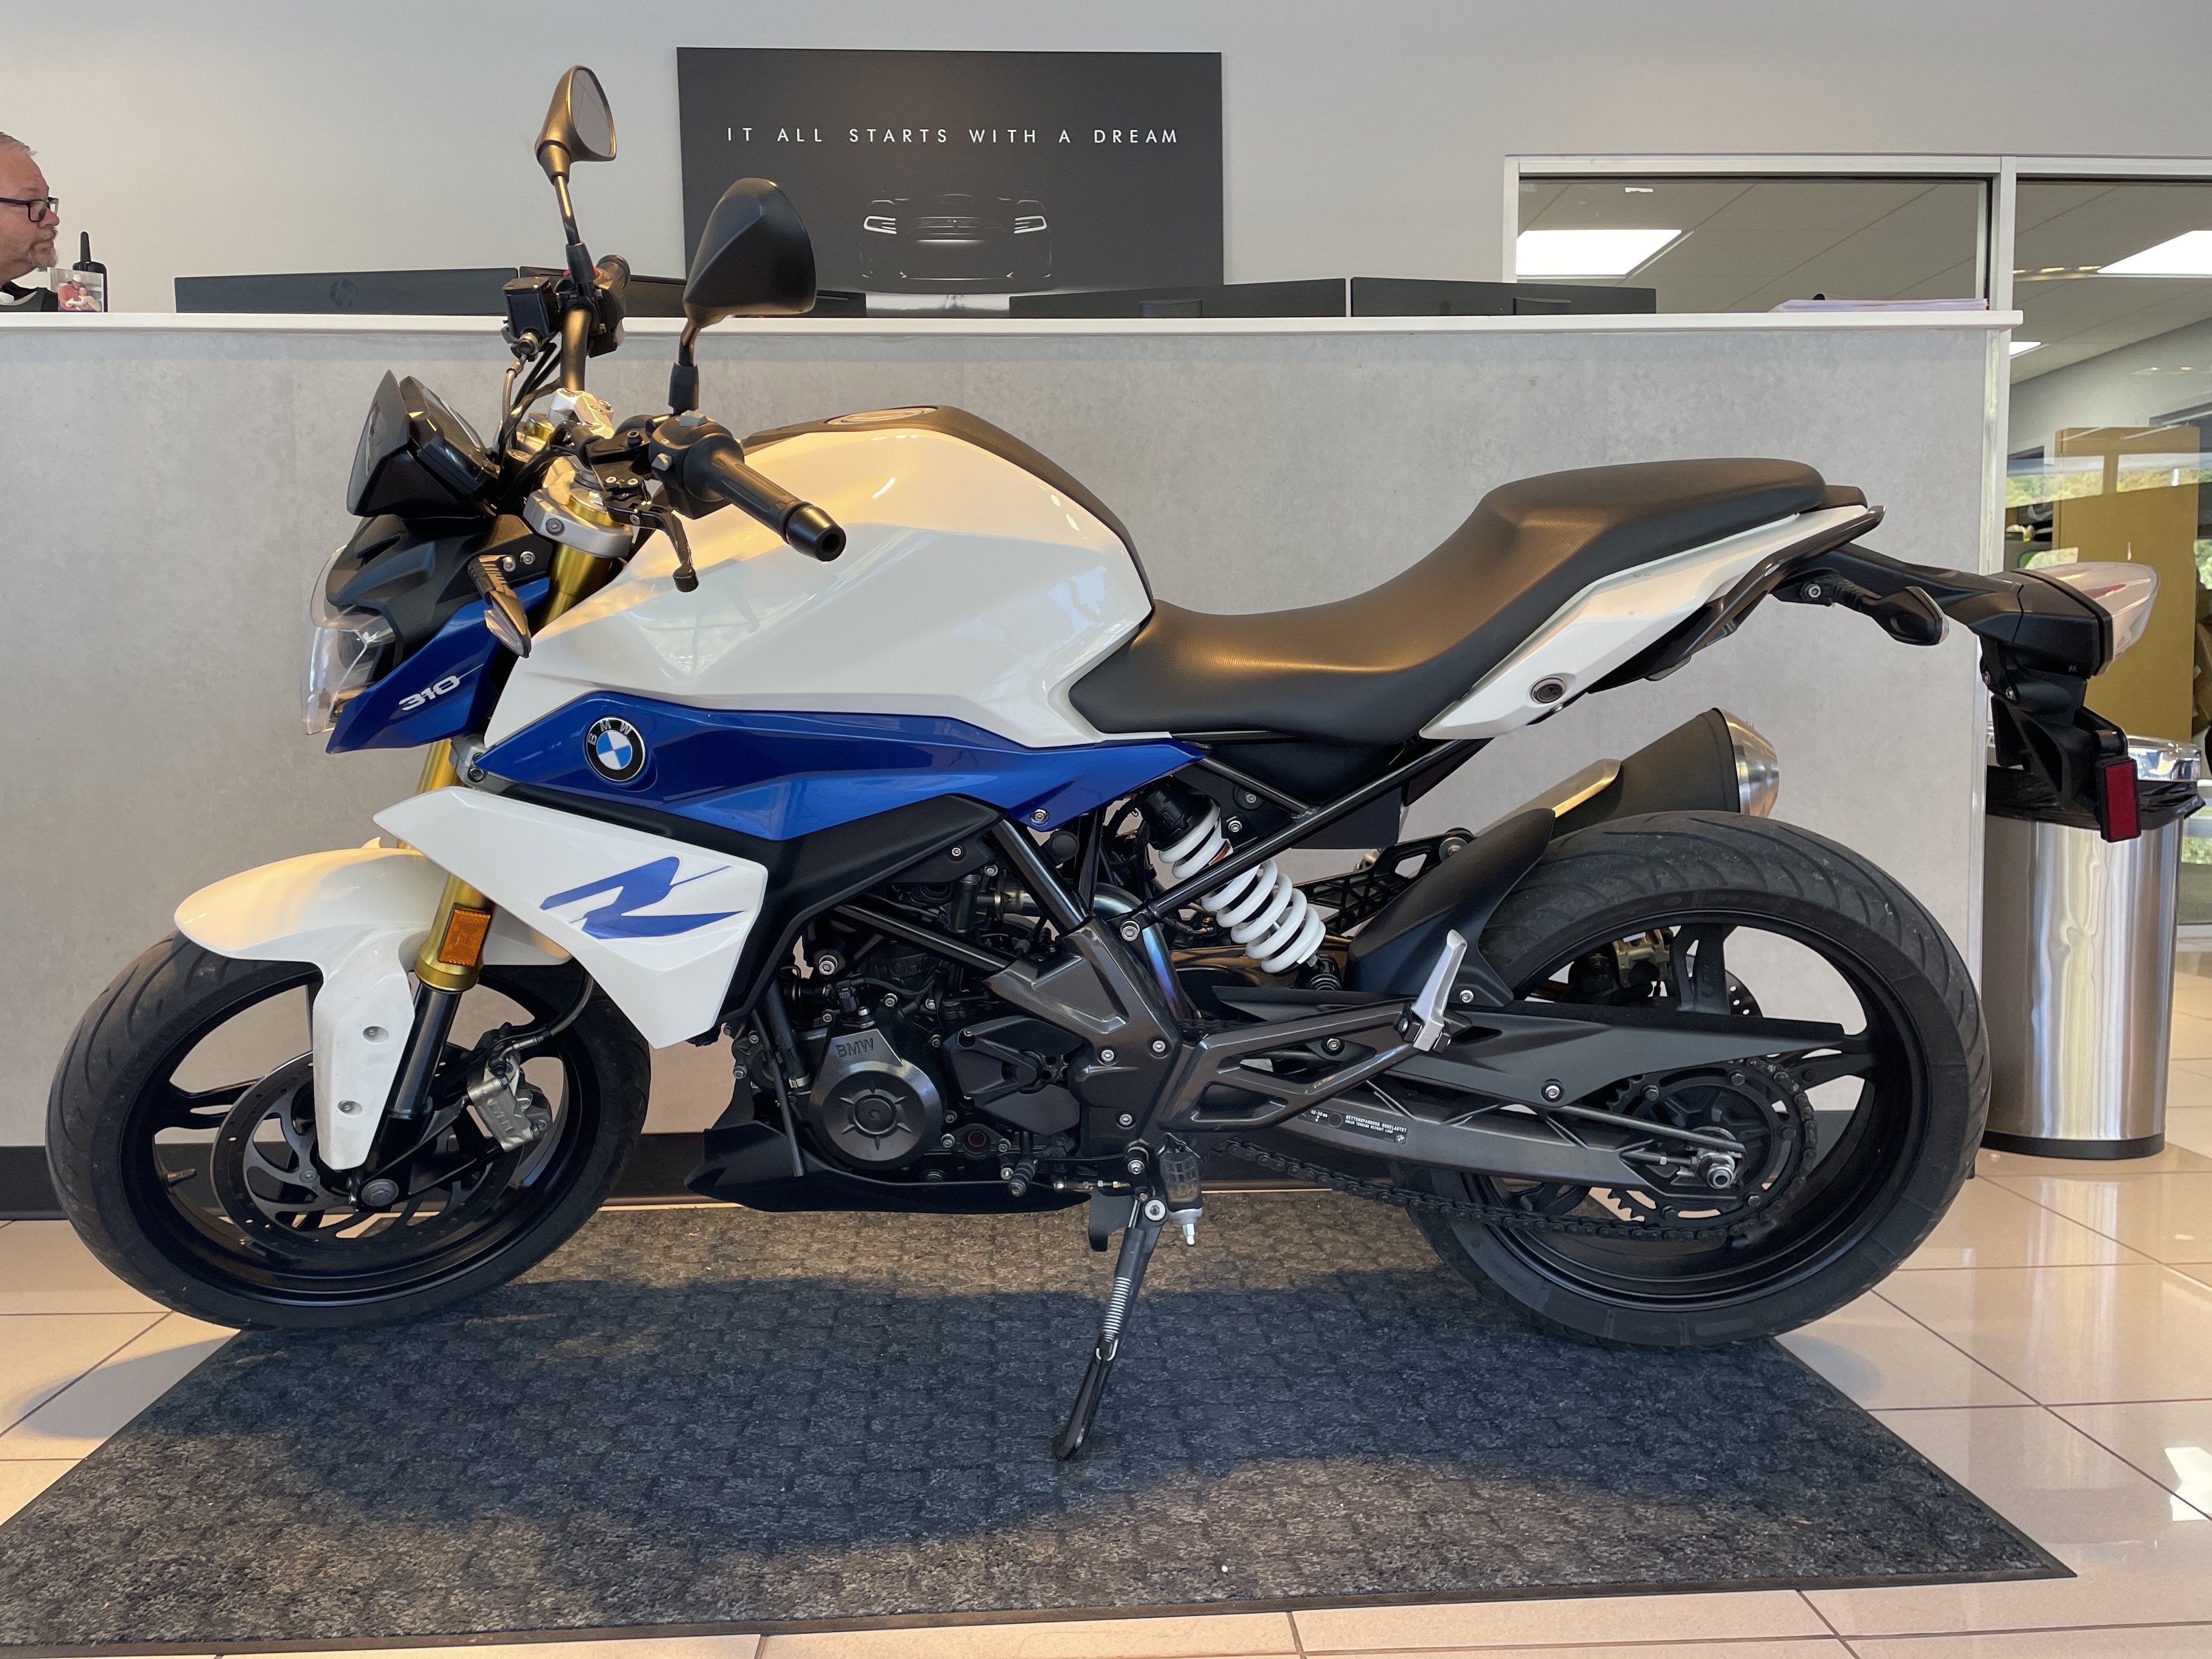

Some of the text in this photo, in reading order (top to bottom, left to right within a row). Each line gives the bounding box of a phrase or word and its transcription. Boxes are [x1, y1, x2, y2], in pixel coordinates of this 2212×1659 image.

[727, 127, 1177, 143] IT ALL STARTS WITH A DREAM
[399, 675, 460, 711] 310
[588, 719, 631, 746] BMW
[836, 1038, 873, 1058] BMW
